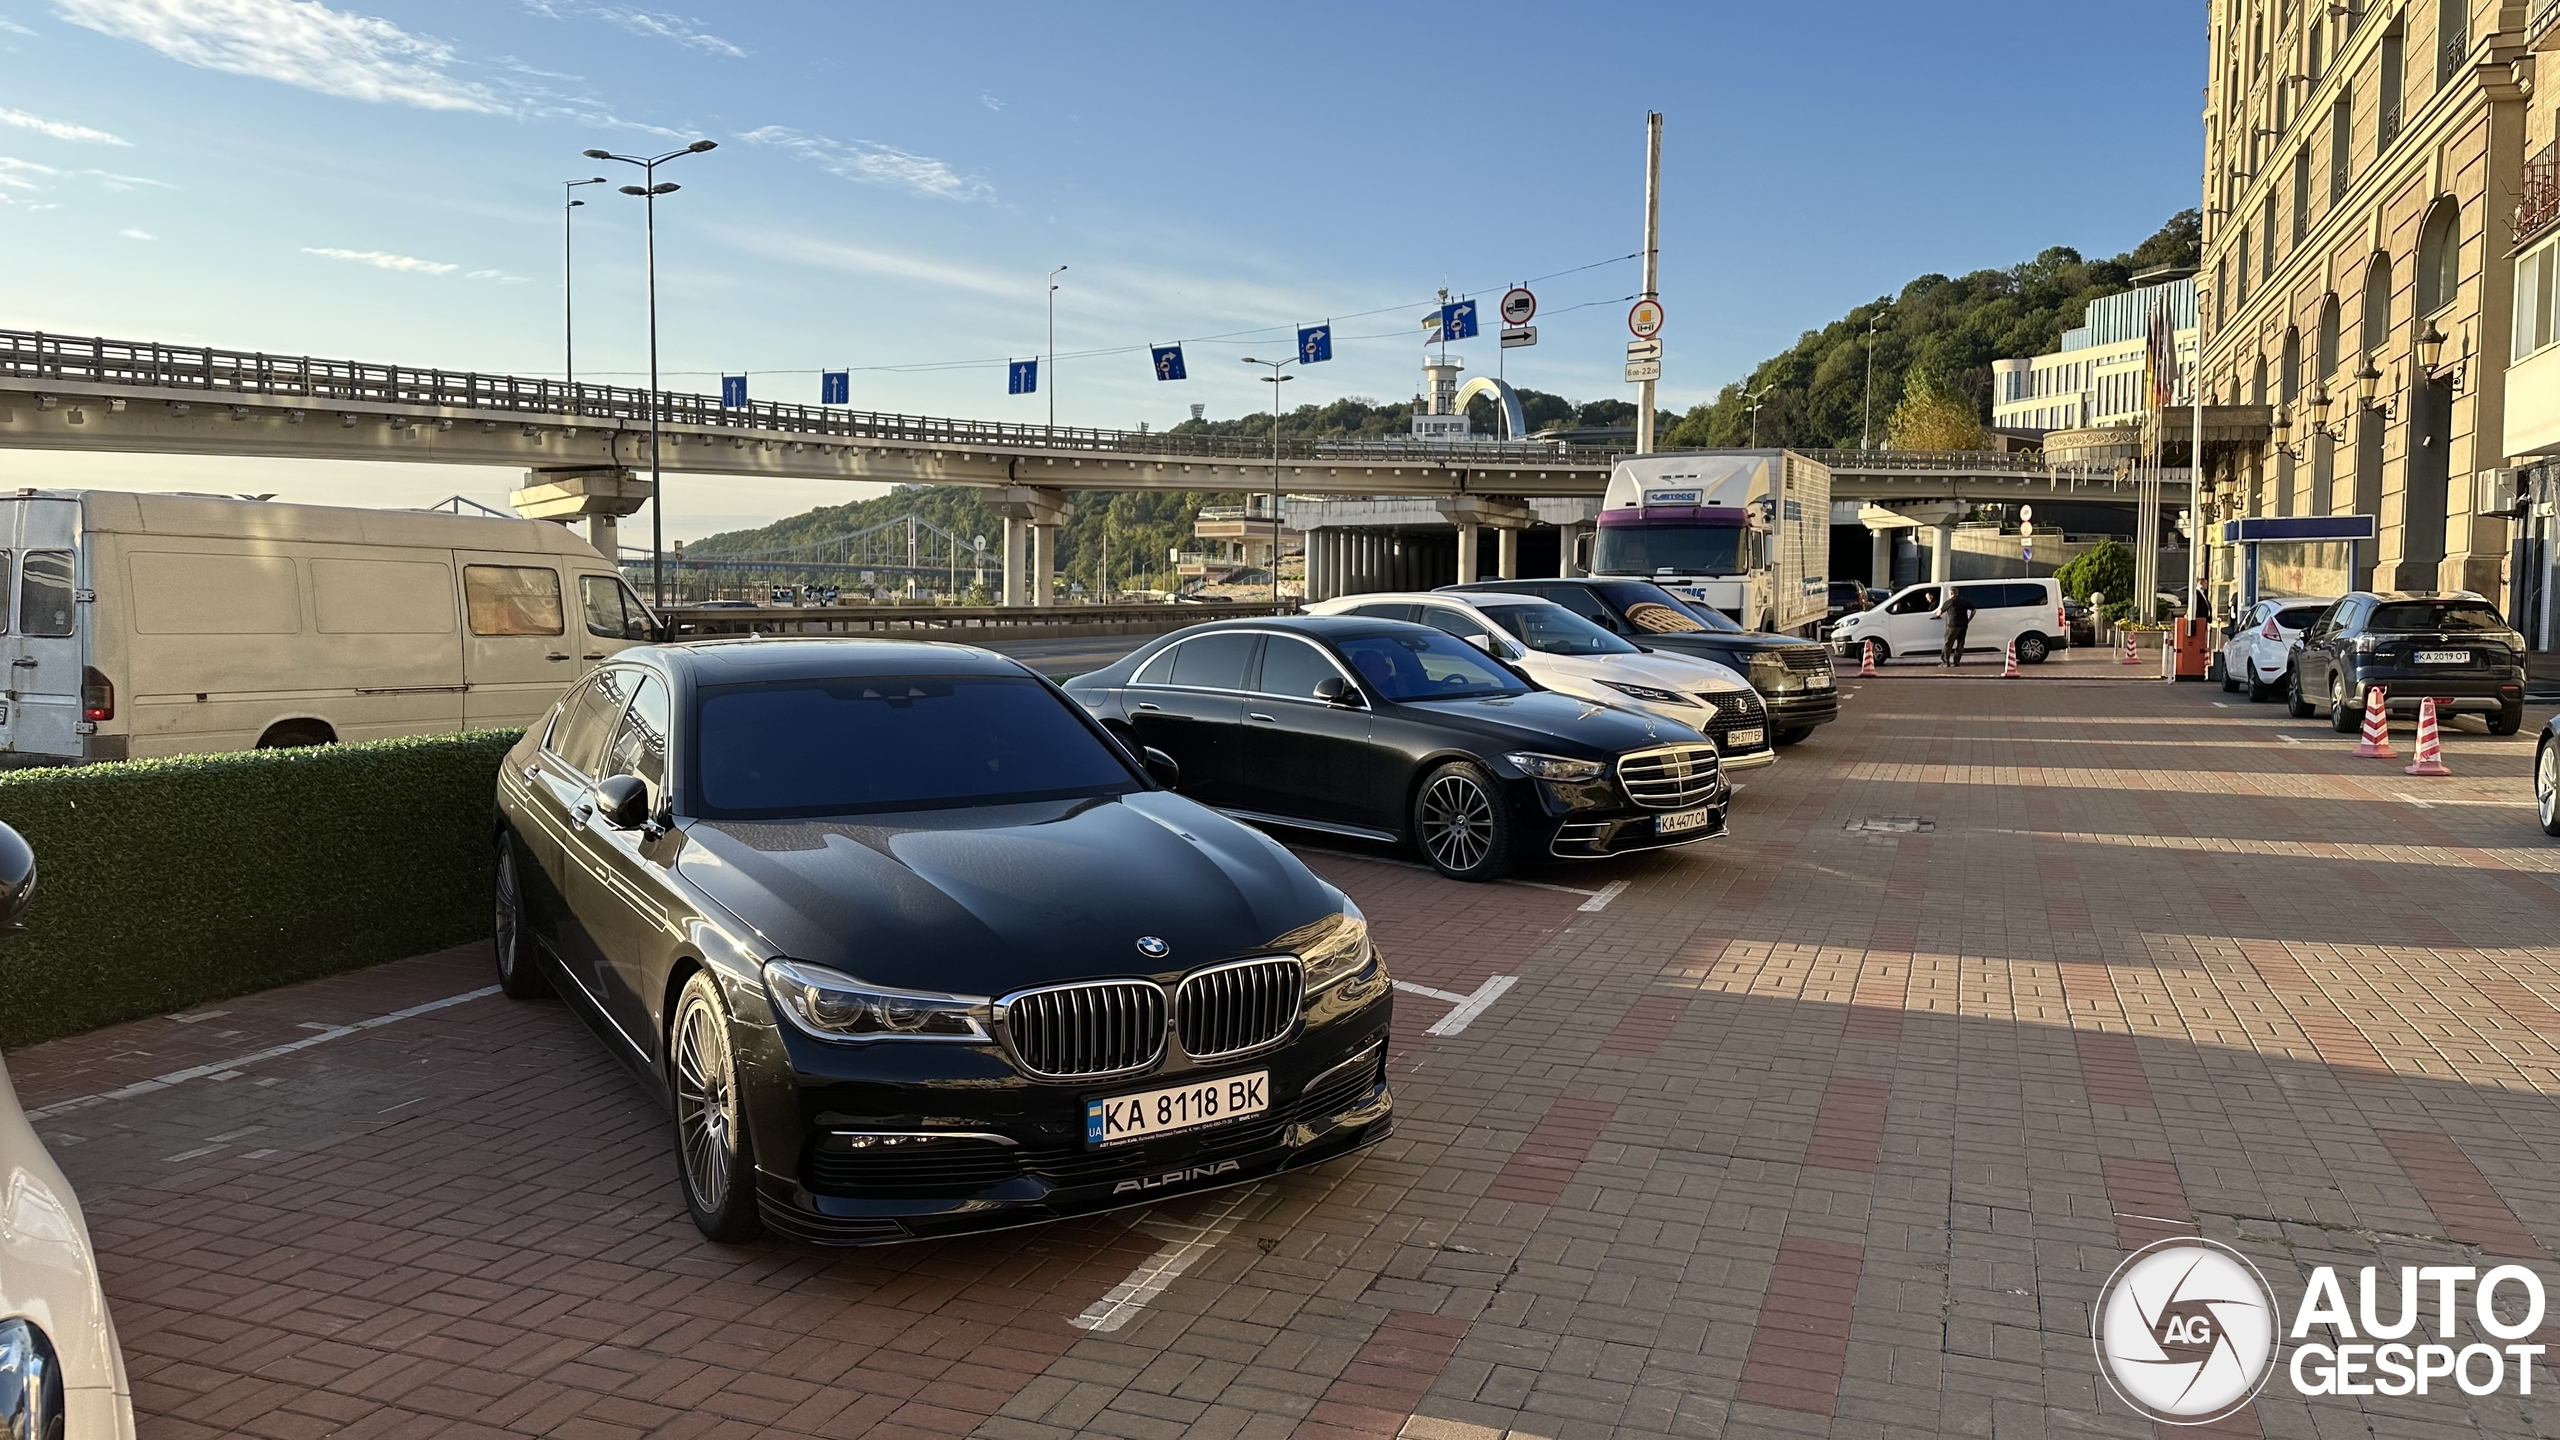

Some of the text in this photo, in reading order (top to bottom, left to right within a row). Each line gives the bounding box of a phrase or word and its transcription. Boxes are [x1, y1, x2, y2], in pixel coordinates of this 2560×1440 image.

[1651, 492, 1696, 501] CARTOCCI
[2419, 652, 2469, 661] KA 2019 OT
[1731, 732, 1740, 744] BH
[1662, 811, 1706, 831] KA 4477 CA
[1105, 1076, 1265, 1135] KA 8118 BK
[1088, 1126, 1102, 1138] UA
[1112, 1159, 1241, 1195] ALPINA
